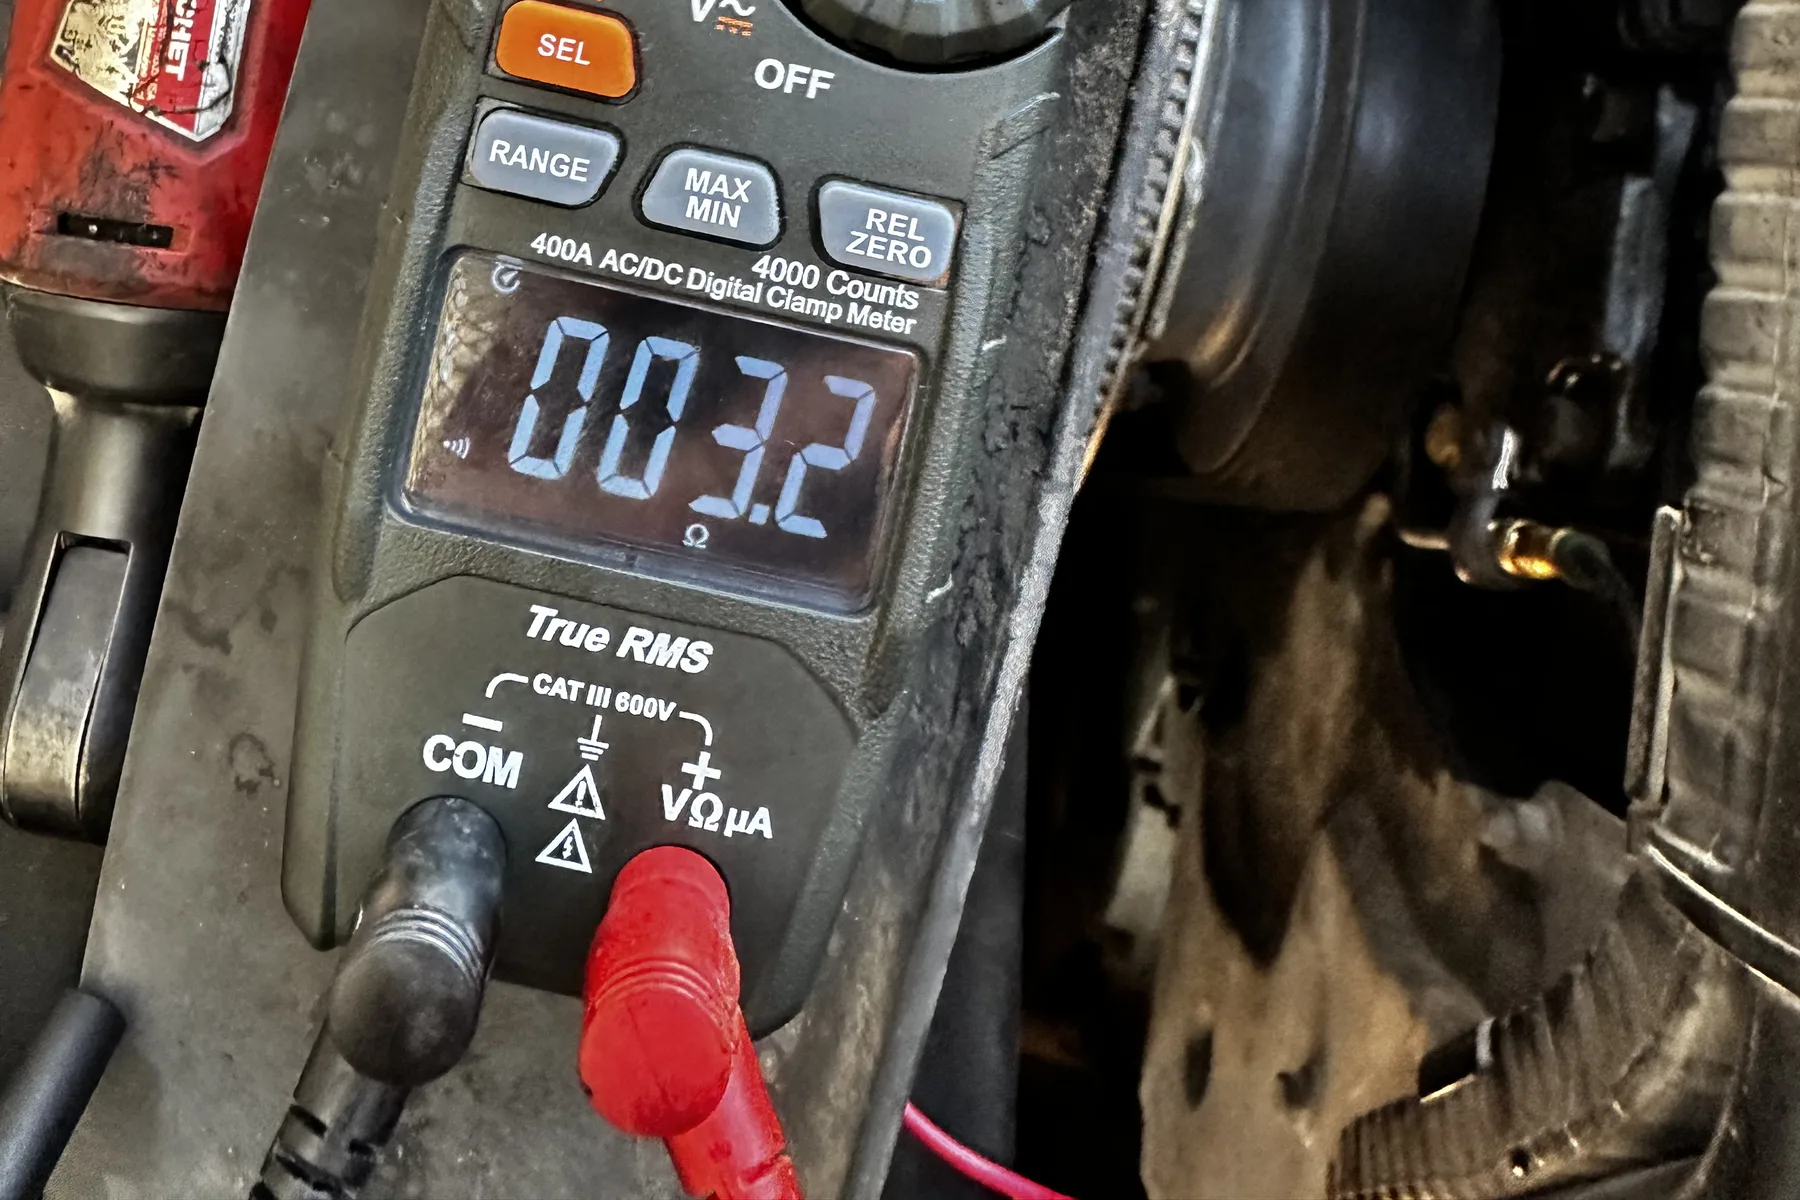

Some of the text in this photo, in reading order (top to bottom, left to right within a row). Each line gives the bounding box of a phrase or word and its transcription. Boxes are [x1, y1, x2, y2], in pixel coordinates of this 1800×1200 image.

[536, 33, 592, 67] SEL
[754, 58, 836, 100] OFF
[489, 139, 591, 183] RANGE
[684, 167, 753, 203] MAX
[685, 194, 742, 228] MIN
[866, 208, 925, 242] REL
[530, 232, 683, 287] 400A AC/DC
[845, 230, 932, 269] ZERO
[686, 267, 918, 335] Digital Clamp Meter
[752, 254, 920, 311] 4000 Counts
[508, 315, 877, 539] 003.2
[526, 604, 714, 675] True RMS
[532, 672, 585, 703] CAT
[614, 691, 678, 722] 600V
[422, 733, 525, 790] COM
